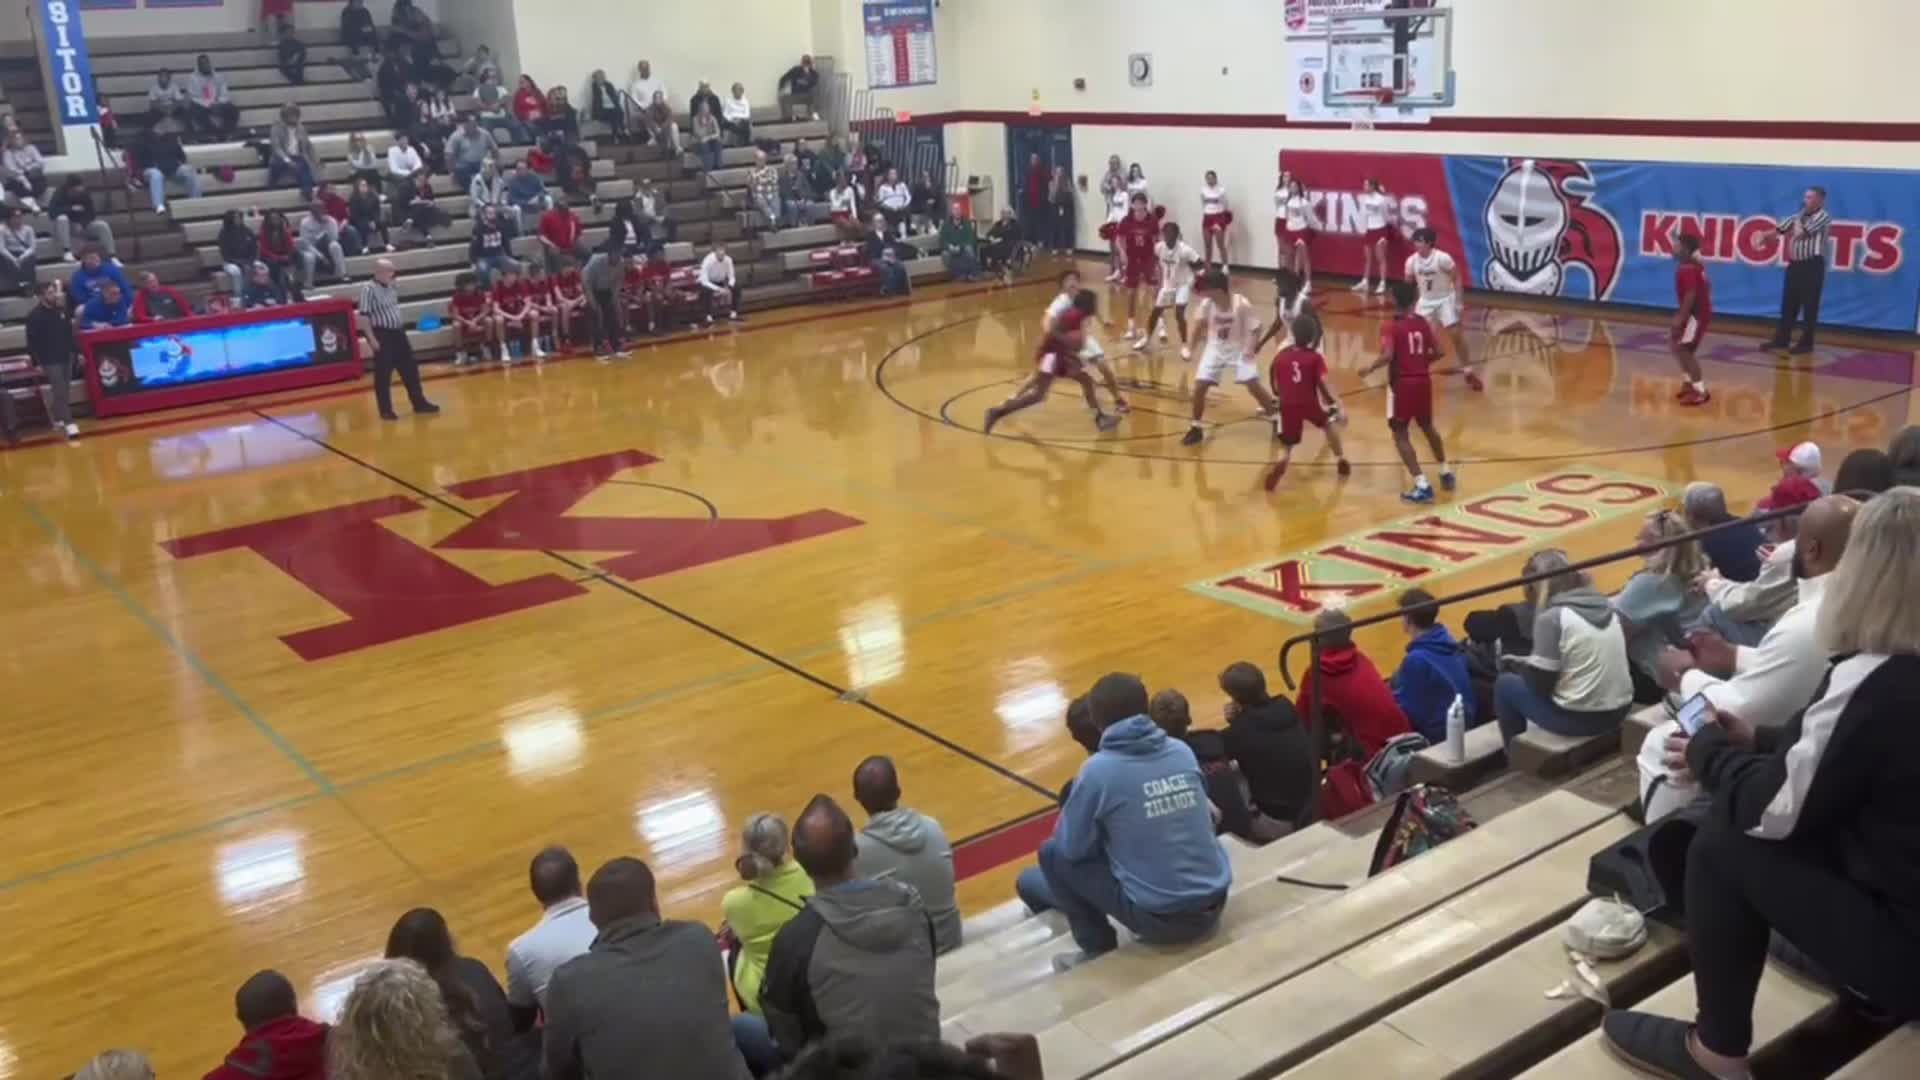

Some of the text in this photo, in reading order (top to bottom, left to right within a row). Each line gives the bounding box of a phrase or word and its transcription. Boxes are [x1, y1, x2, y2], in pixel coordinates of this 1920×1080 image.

[1291, 360, 1303, 384] 3
[160, 448, 865, 661] K
[1213, 470, 1666, 614] KINGS
[1143, 774, 1189, 797] COACH
